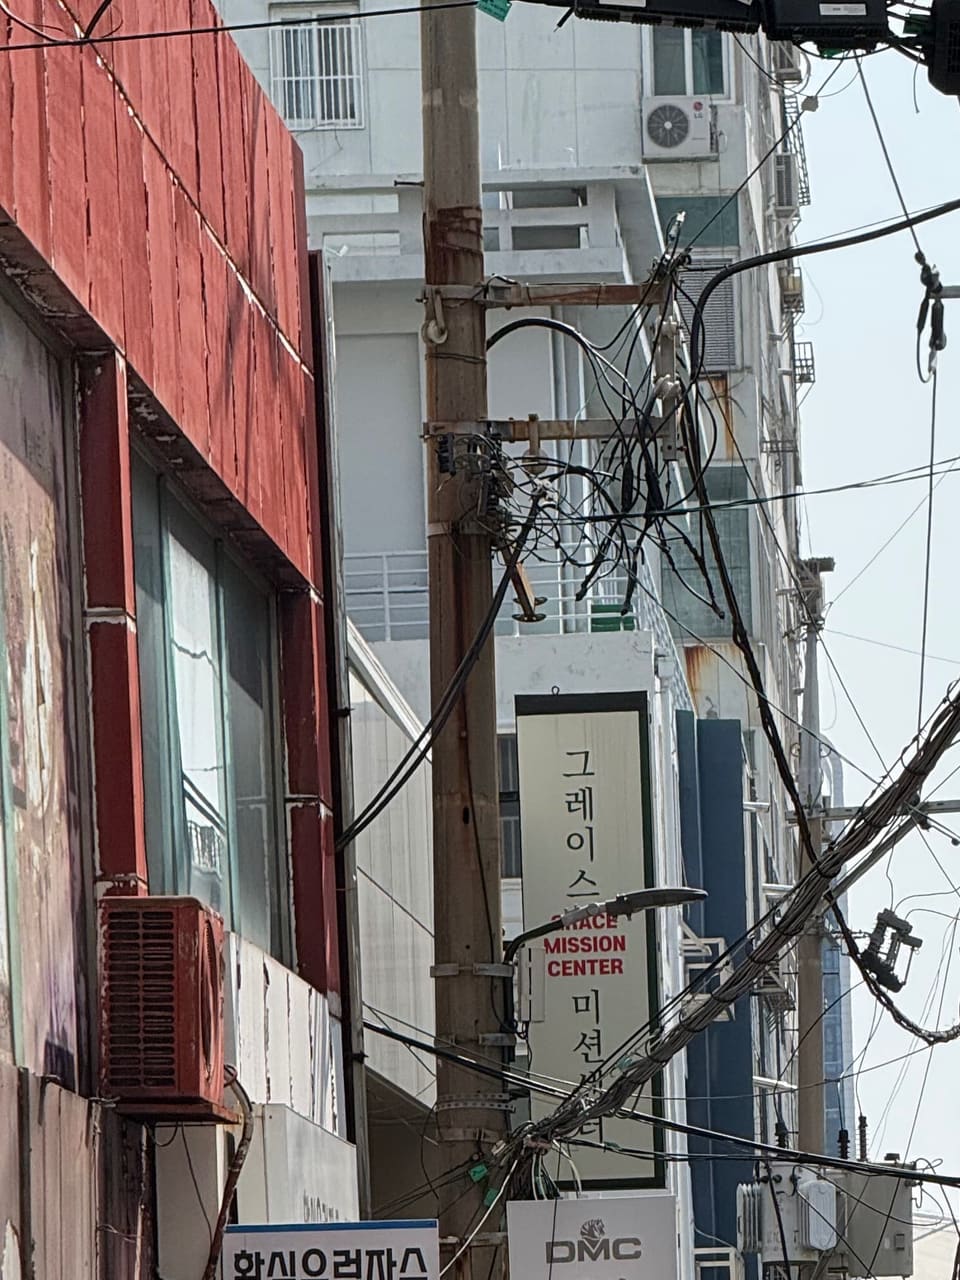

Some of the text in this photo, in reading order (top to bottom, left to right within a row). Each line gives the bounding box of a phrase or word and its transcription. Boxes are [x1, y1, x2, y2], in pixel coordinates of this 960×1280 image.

[562, 749, 600, 898] 그레이스
[543, 935, 626, 955] MISSION
[547, 958, 623, 977] CENTER
[545, 1238, 643, 1264] DMC
